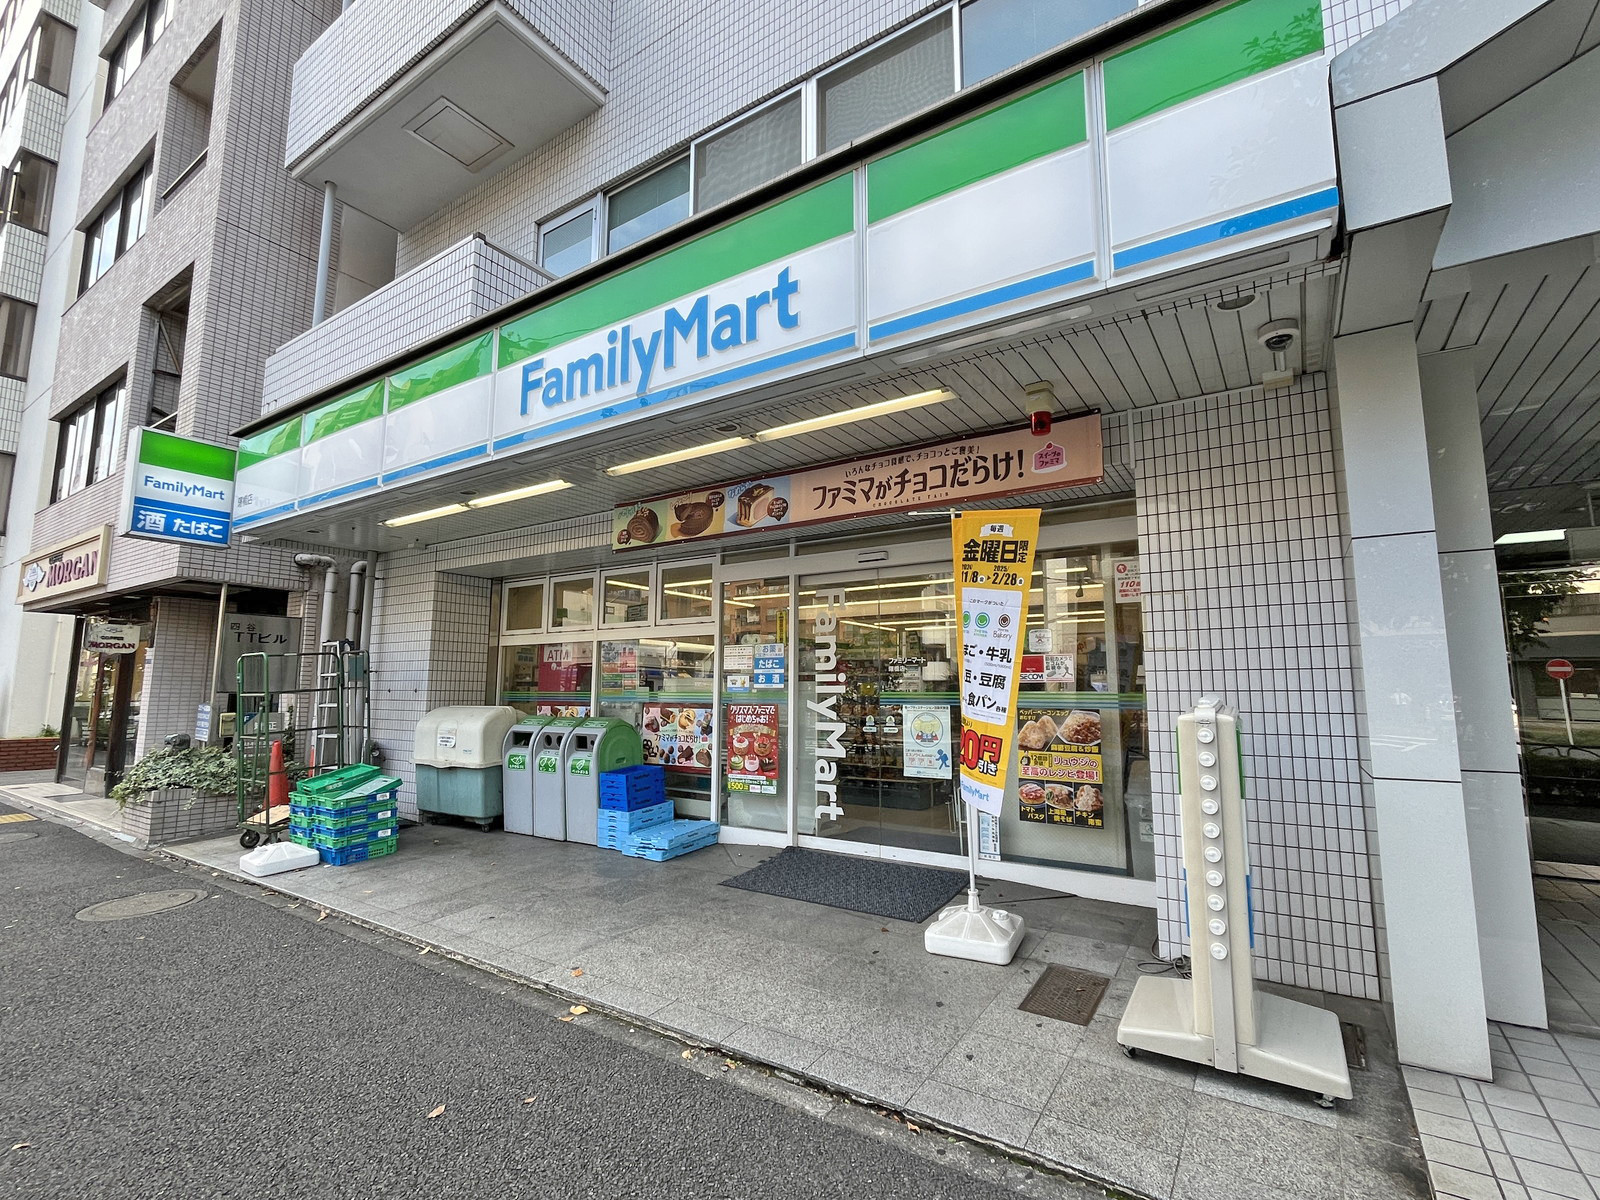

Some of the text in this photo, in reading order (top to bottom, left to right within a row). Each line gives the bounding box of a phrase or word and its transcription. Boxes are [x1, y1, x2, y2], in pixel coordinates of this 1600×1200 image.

[520, 266, 799, 416] FamilyMart
[1039, 458, 1060, 467] ファミマ
[144, 475, 225, 500] FamilyMart
[812, 449, 1025, 510] ファミマがチョコだらけ!
[136, 510, 223, 538] 酒 たばこ
[990, 524, 1005, 533] 毎週
[962, 538, 1029, 563] 金曜日 限定
[46, 550, 99, 588] MORGAN
[234, 631, 288, 644] TTビル
[992, 631, 1013, 642] Bakery
[88, 641, 135, 649] MORGAN
[758, 659, 780, 668] たばこ
[806, 587, 847, 821] FamilyMart
[967, 691, 997, 709] 食パン
[978, 759, 998, 777] 引き
[1053, 756, 1098, 768] リュウジの
[1021, 766, 1099, 781] 至高のレシピ登場!
[1028, 812, 1045, 820] パスタ
